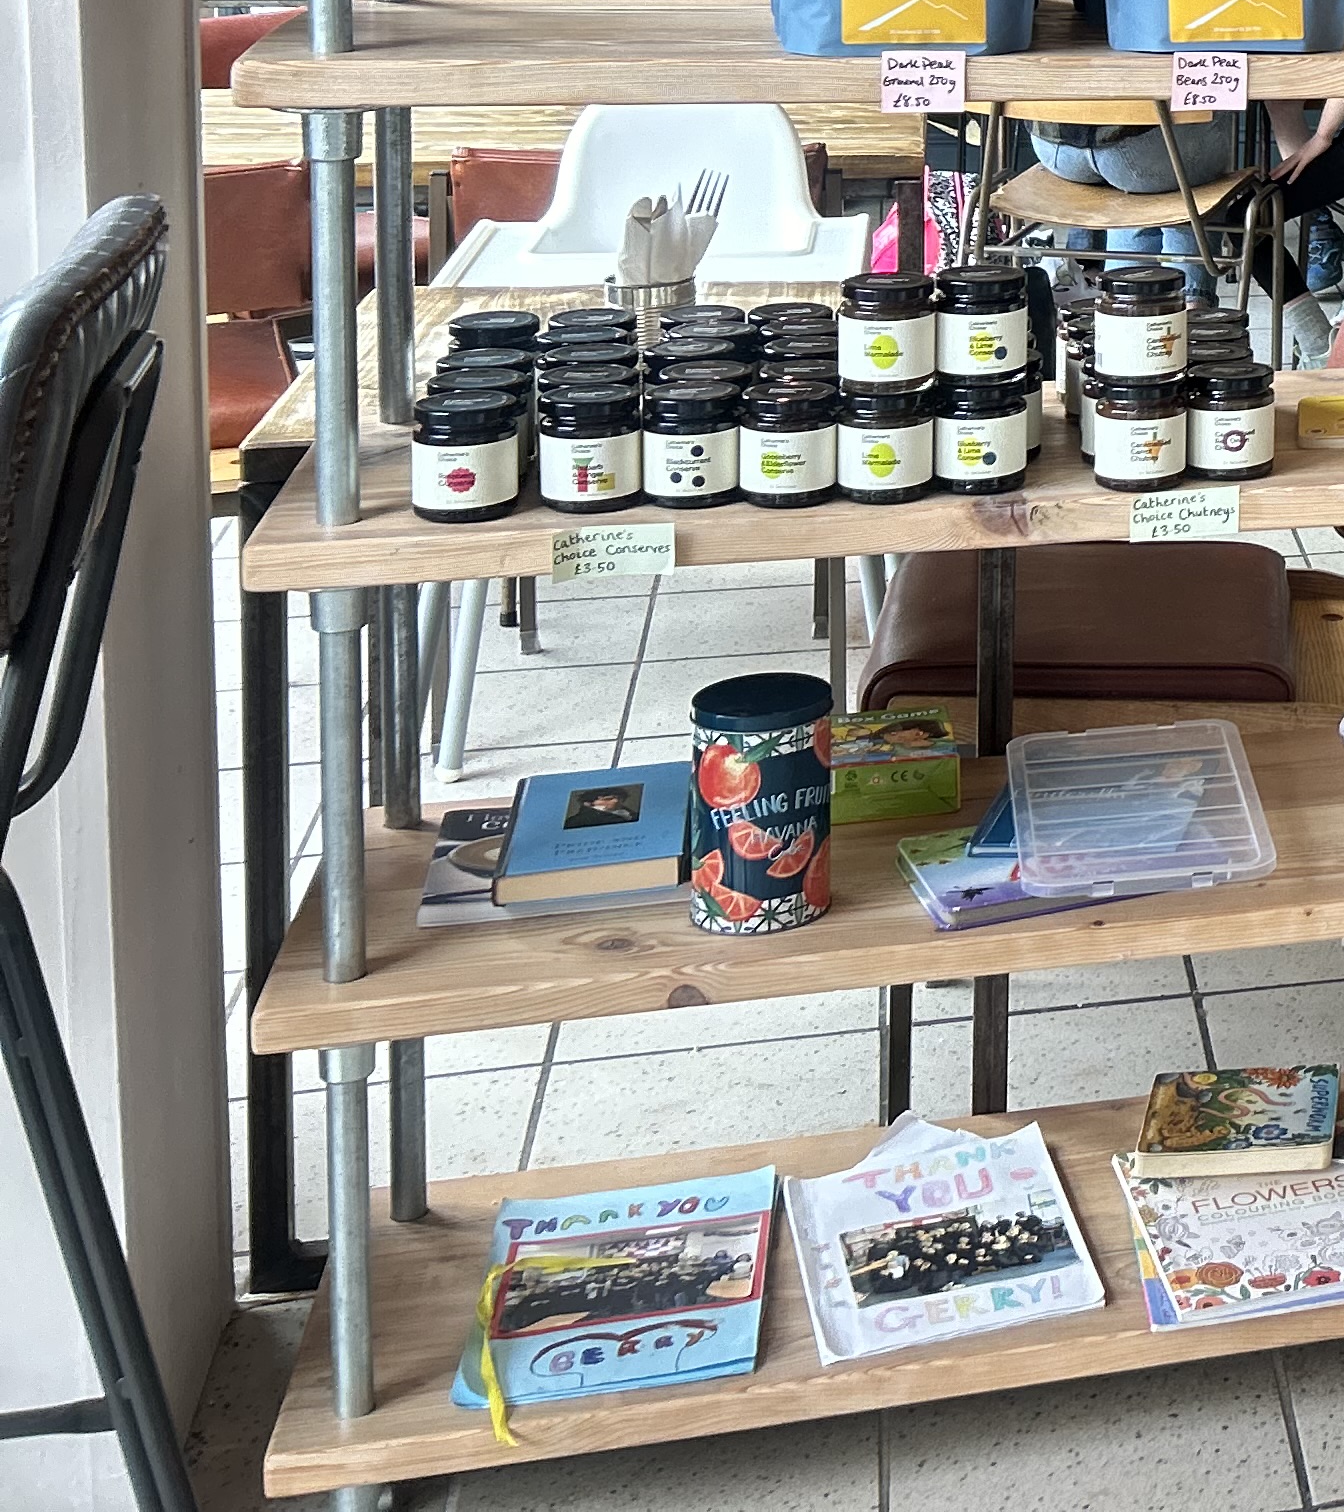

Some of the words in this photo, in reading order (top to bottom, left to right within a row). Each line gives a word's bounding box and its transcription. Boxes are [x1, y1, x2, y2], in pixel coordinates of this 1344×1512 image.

[887, 57, 920, 71] Dark
[1211, 55, 1242, 70] Peak
[1210, 73, 1240, 92] 250g
[892, 92, 931, 108] £8.50
[1132, 491, 1206, 511] Catherine's
[1132, 509, 1174, 524] Choice
[1178, 505, 1236, 524] Chutneys
[553, 528, 635, 552] Catherine's
[553, 547, 598, 566] Choice
[605, 543, 672, 556] Conserves
[835, 713, 877, 725] Box
[879, 706, 941, 722] Game
[708, 790, 791, 831] FEELING
[748, 815, 819, 845] HAVANA
[1305, 1077, 1330, 1133] SUPERWORM
[841, 1138, 1019, 1190] THANK
[873, 1166, 995, 1214] YOU
[1197, 1197, 1306, 1223] COLOURING
